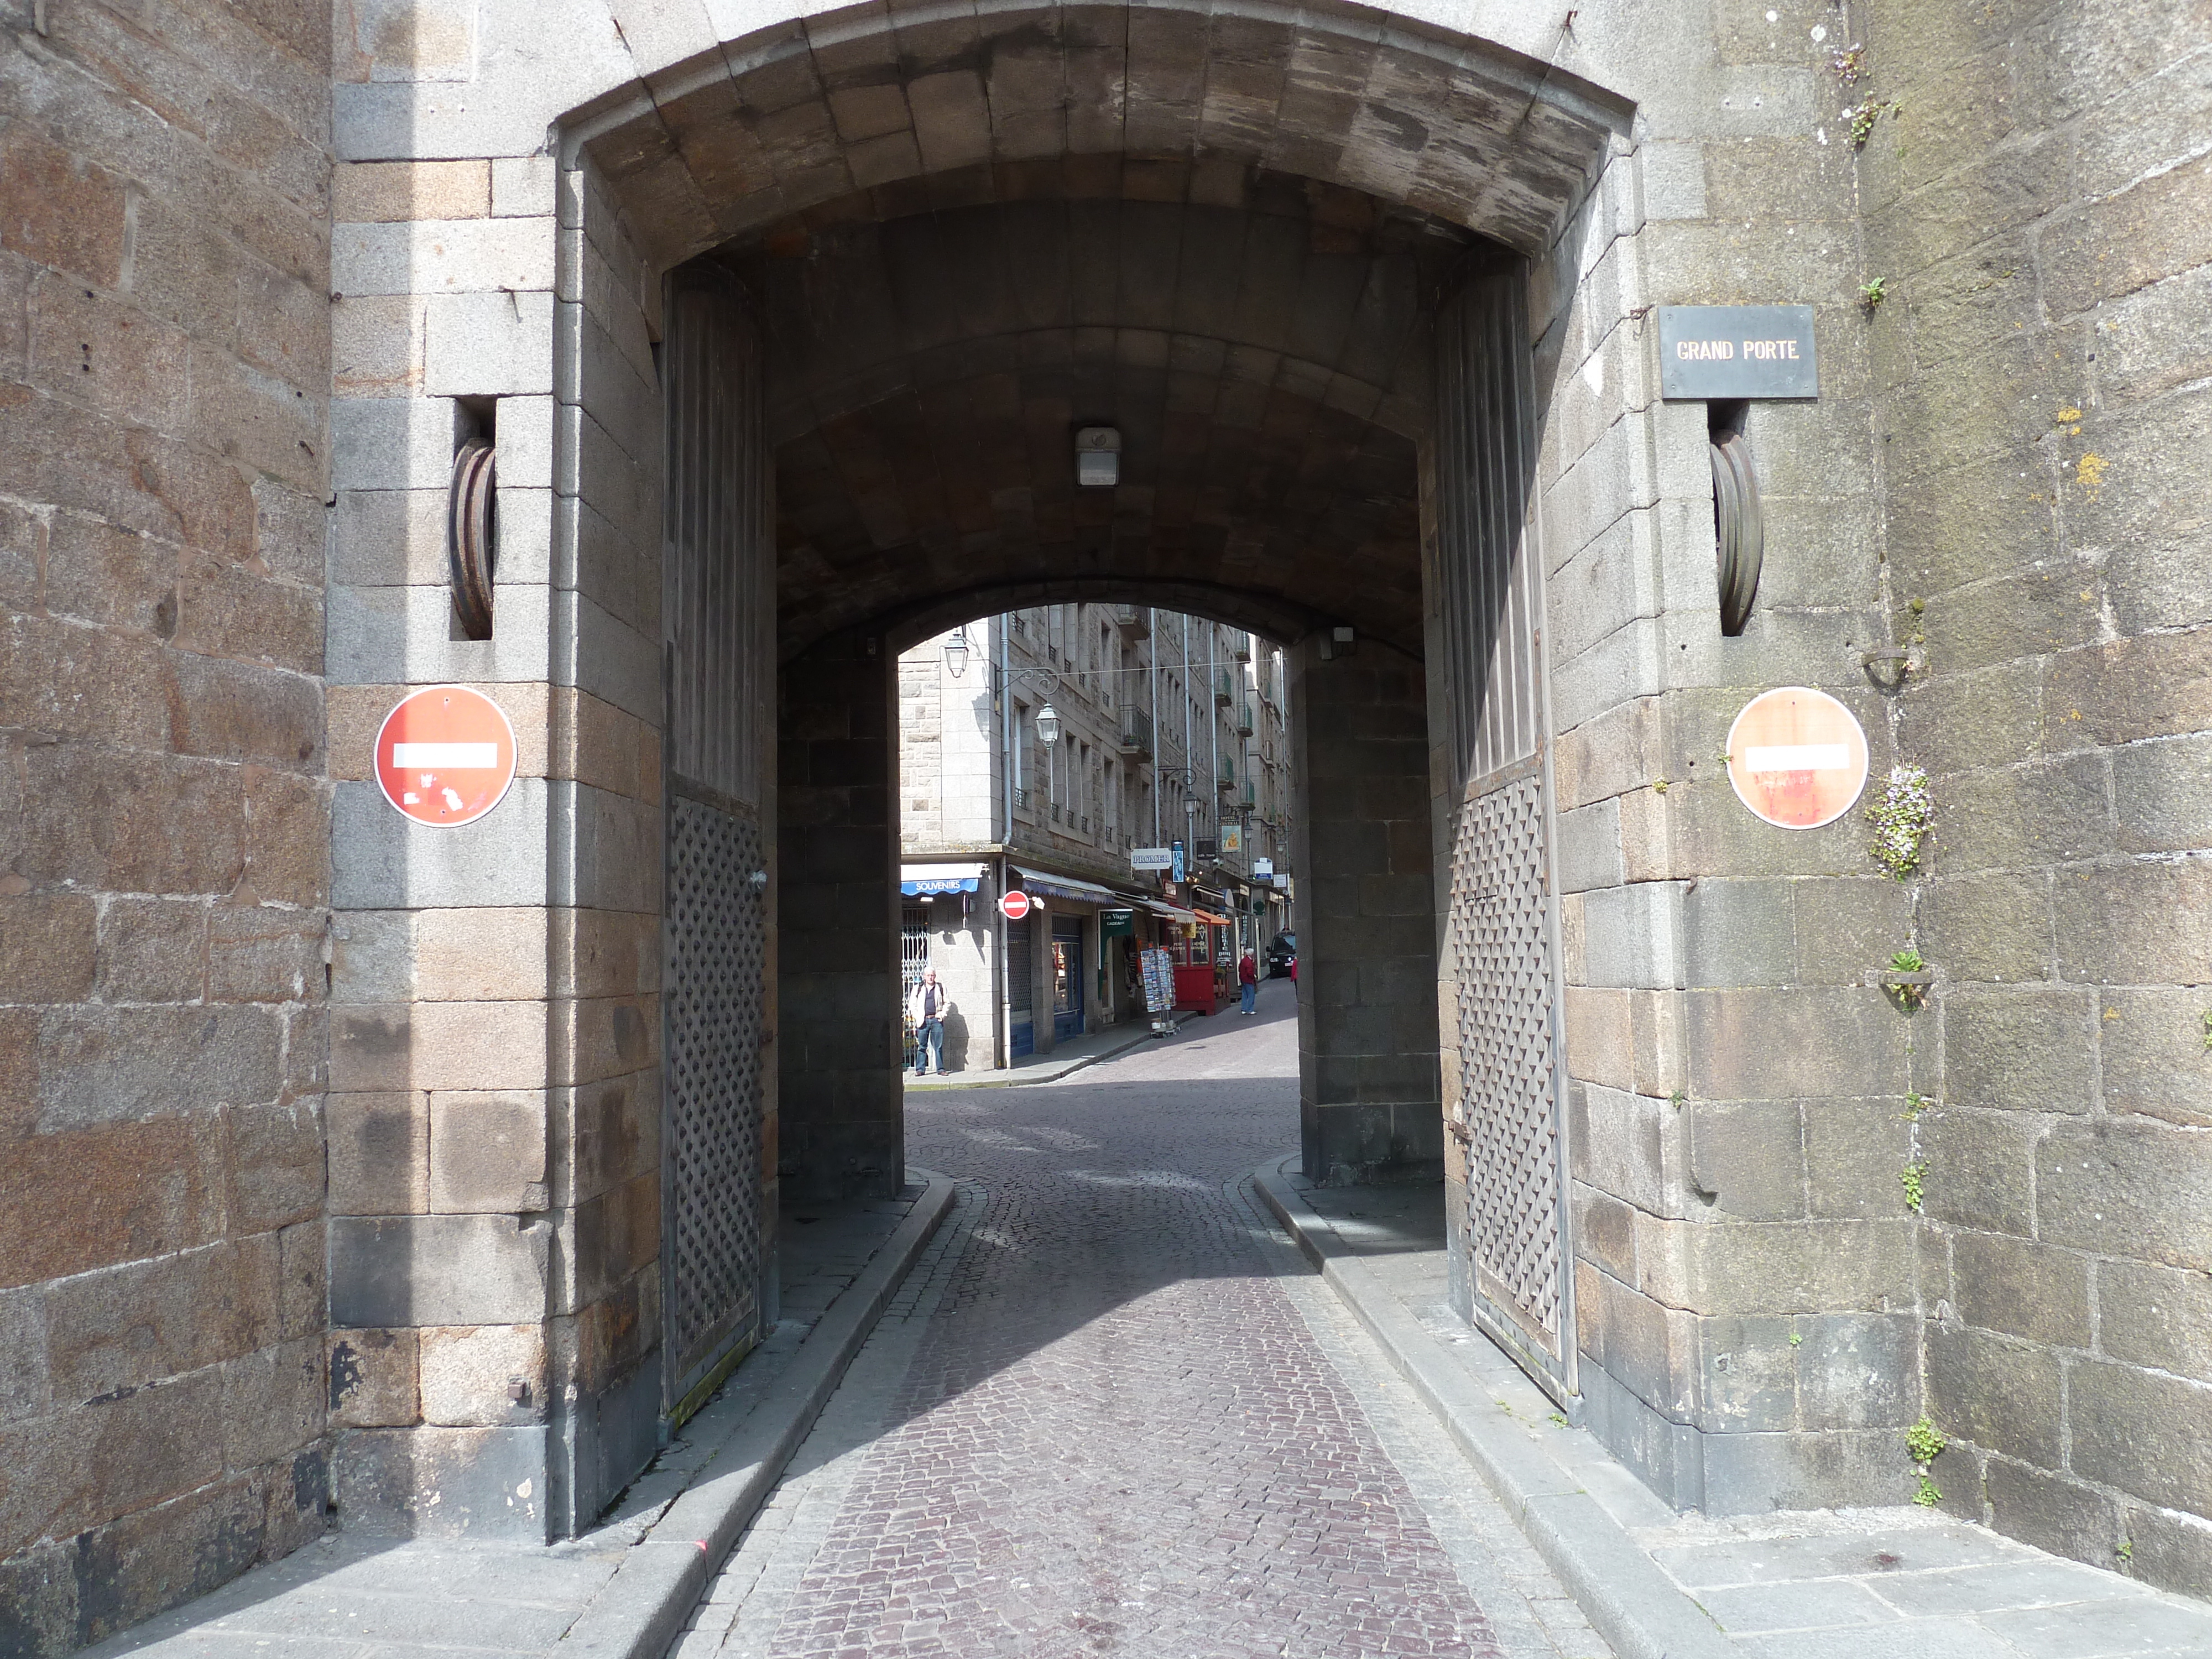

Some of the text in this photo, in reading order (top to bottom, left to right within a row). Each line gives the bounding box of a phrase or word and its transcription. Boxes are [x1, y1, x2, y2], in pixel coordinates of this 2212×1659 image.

[1677, 340, 1799, 360] GRAND PORTE
[1133, 854, 1170, 864] PROMER
[916, 881, 961, 891] SOUVENIRS
